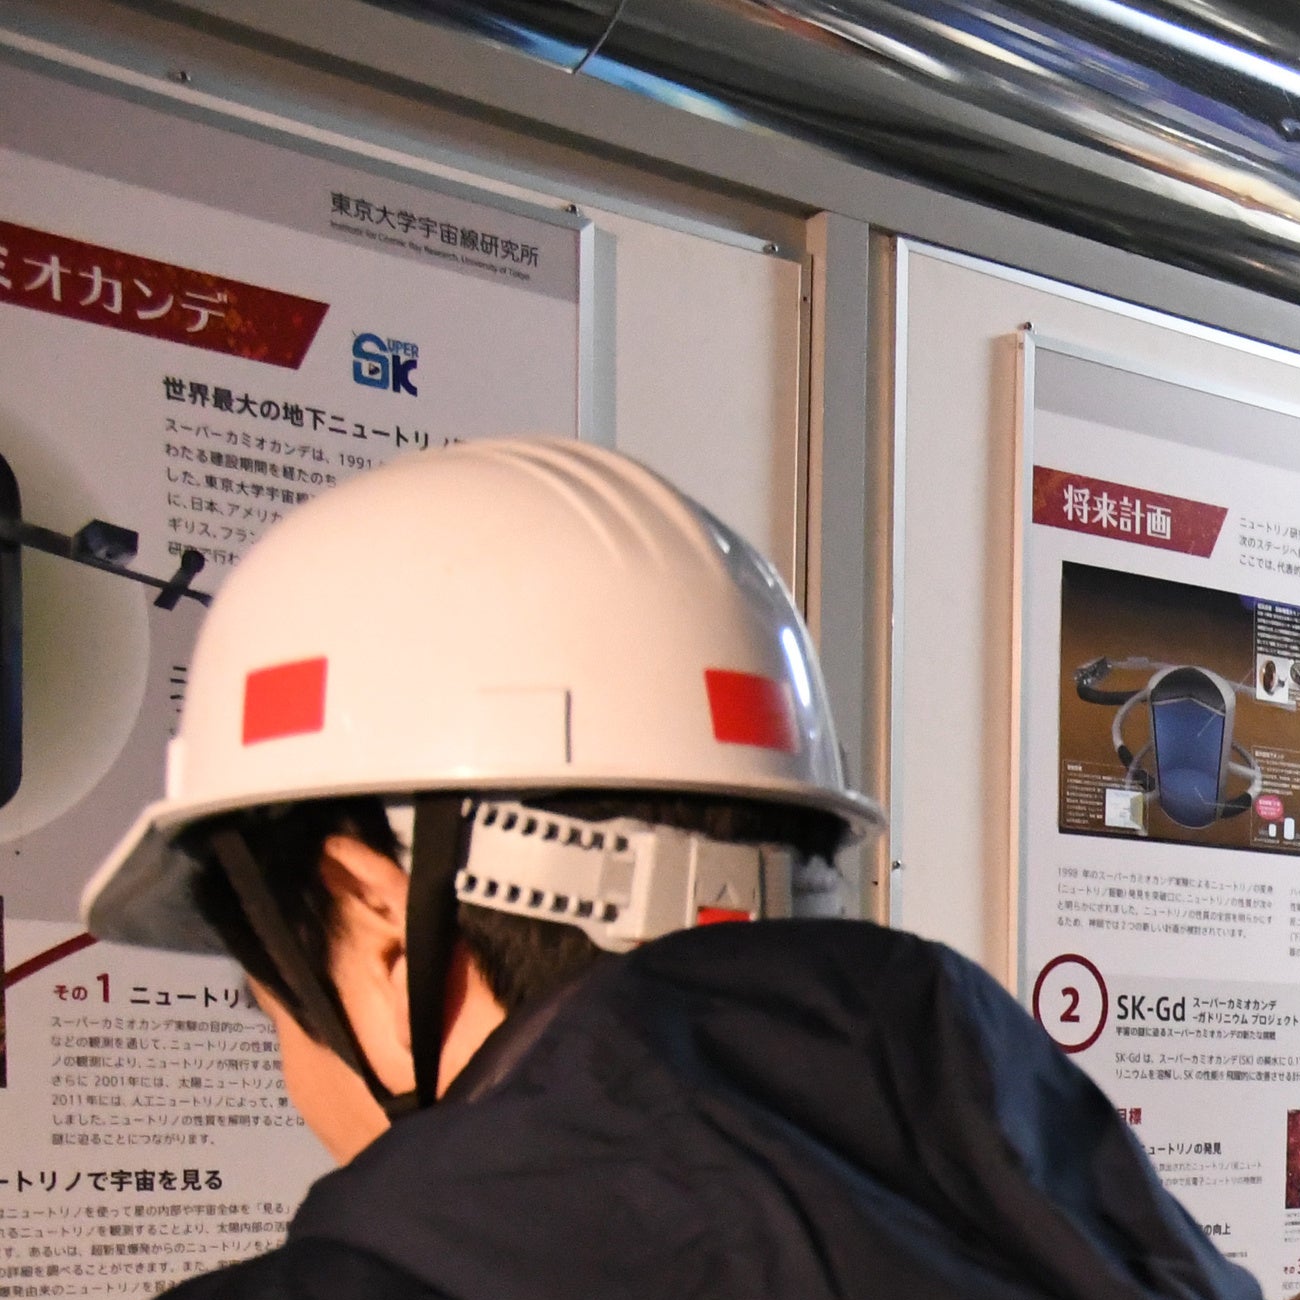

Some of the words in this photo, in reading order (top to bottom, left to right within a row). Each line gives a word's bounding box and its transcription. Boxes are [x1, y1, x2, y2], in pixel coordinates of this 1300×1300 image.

[331, 191, 539, 267] 東京大学宇宙線研究所
[162, 375, 465, 450] 世界最大の地下ニュートリ
[1062, 485, 1172, 541] 将来計画
[129, 986, 252, 1009] ニュートリ
[1059, 987, 1080, 1023] 2
[1116, 994, 1186, 1022] SK-Gd
[1192, 997, 1277, 1011] スーパーカミオカンデ
[1143, 1142, 1222, 1156] ュートリノの発見
